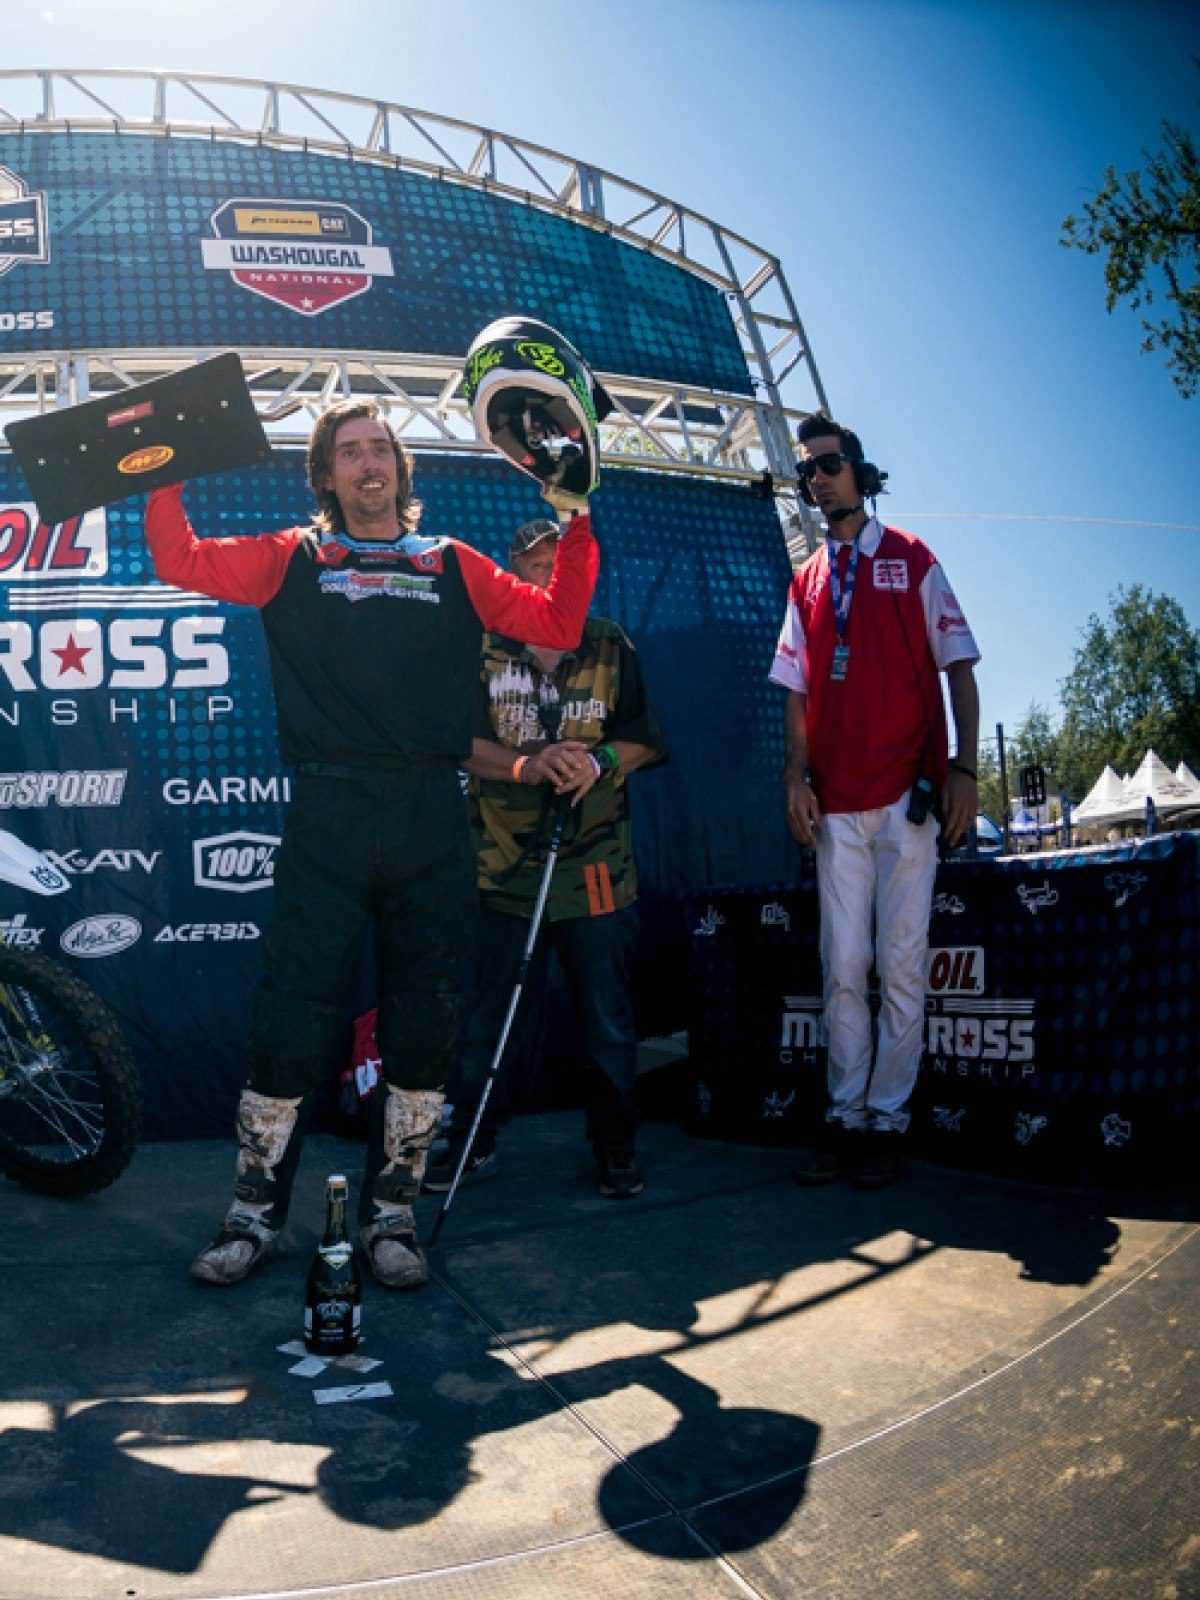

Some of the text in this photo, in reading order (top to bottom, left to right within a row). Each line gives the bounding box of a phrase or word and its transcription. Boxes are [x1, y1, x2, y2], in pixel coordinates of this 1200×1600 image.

[230, 244, 366, 269] WASHOUGAL
[249, 272, 356, 286] NATIONAL
[162, 777, 292, 805] GARMI
[207, 847, 276, 878] 100%
[929, 950, 978, 990] OIL
[781, 1012, 1036, 1061] MROSS
[779, 1050, 1036, 1078] CHNSHIP
